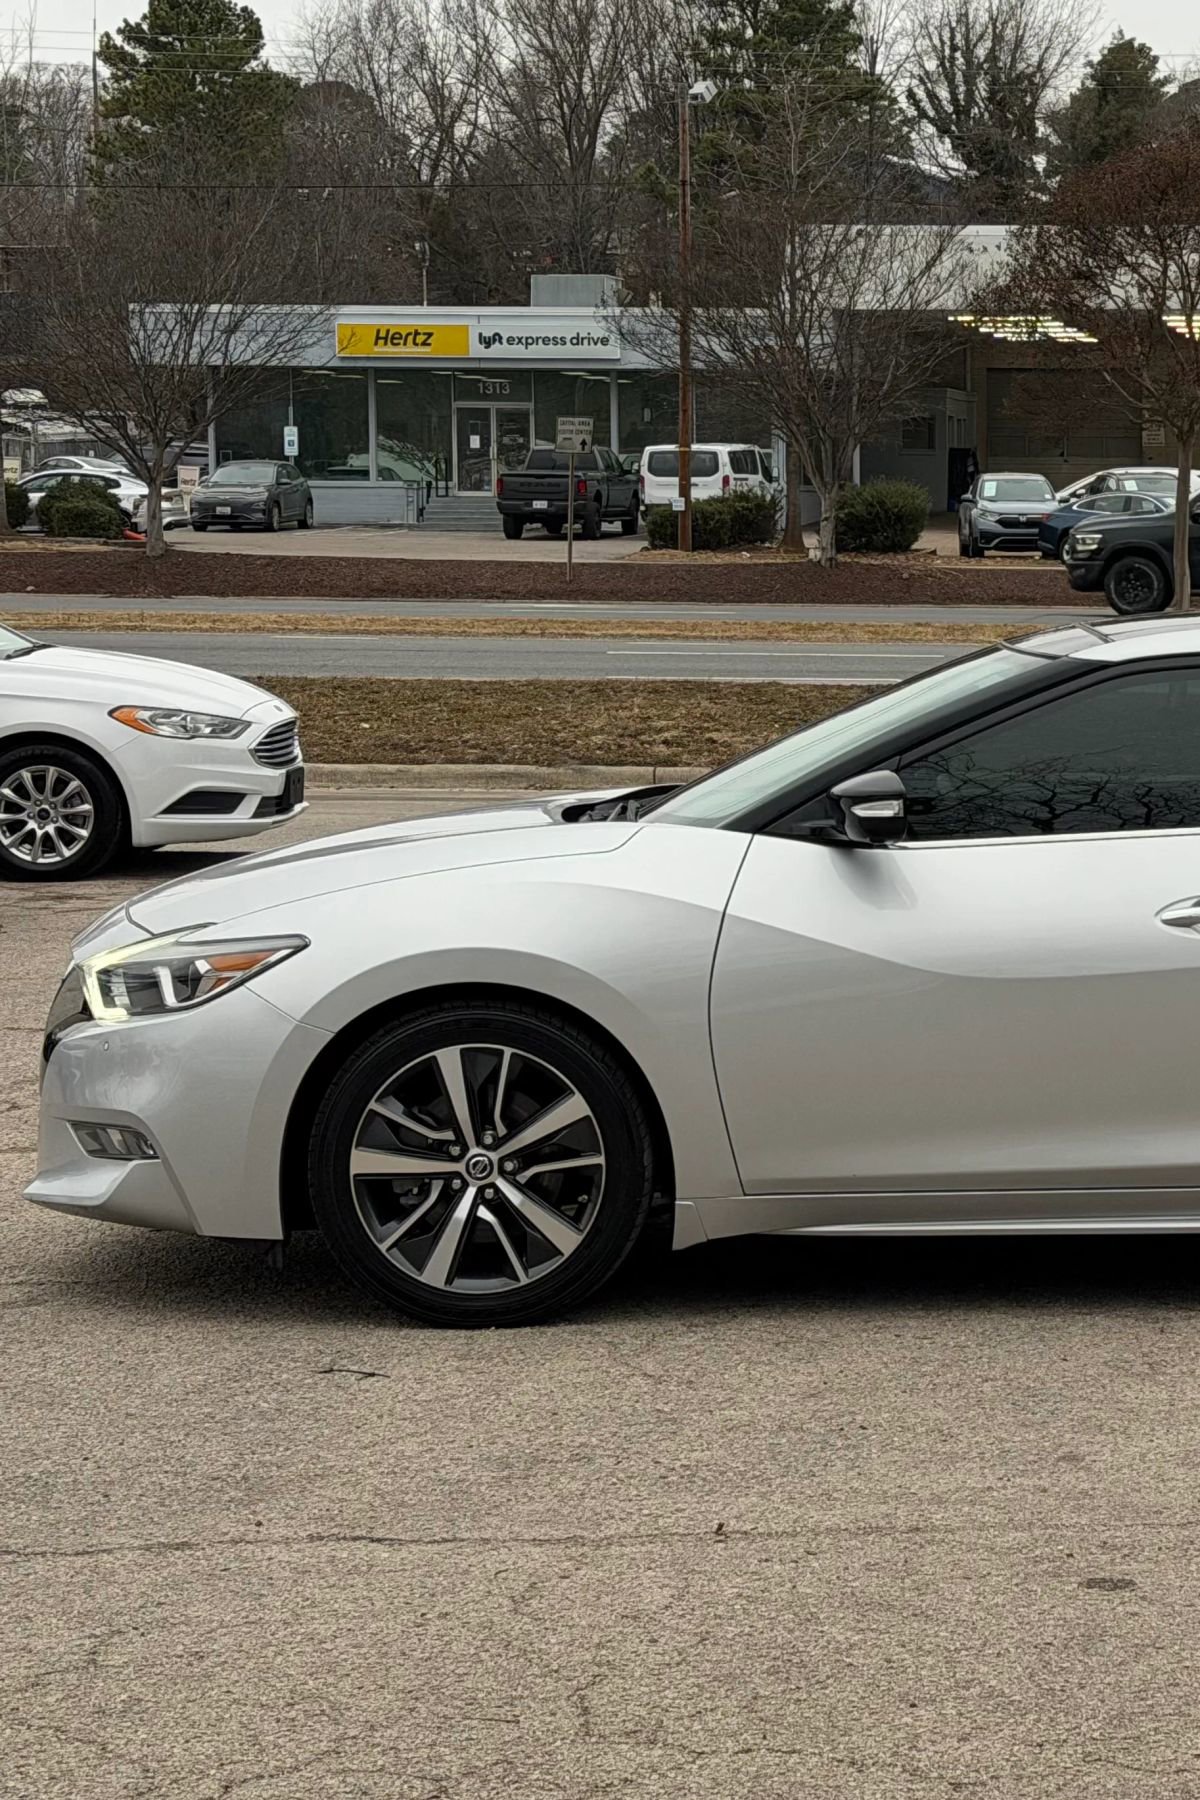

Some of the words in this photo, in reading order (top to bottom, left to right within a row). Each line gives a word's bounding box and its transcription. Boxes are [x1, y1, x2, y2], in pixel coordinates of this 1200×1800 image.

[373, 328, 434, 348] Hertz
[478, 332, 503, 349] lyft
[506, 335, 567, 349] express
[570, 332, 610, 346] drive
[477, 381, 511, 394] 1313
